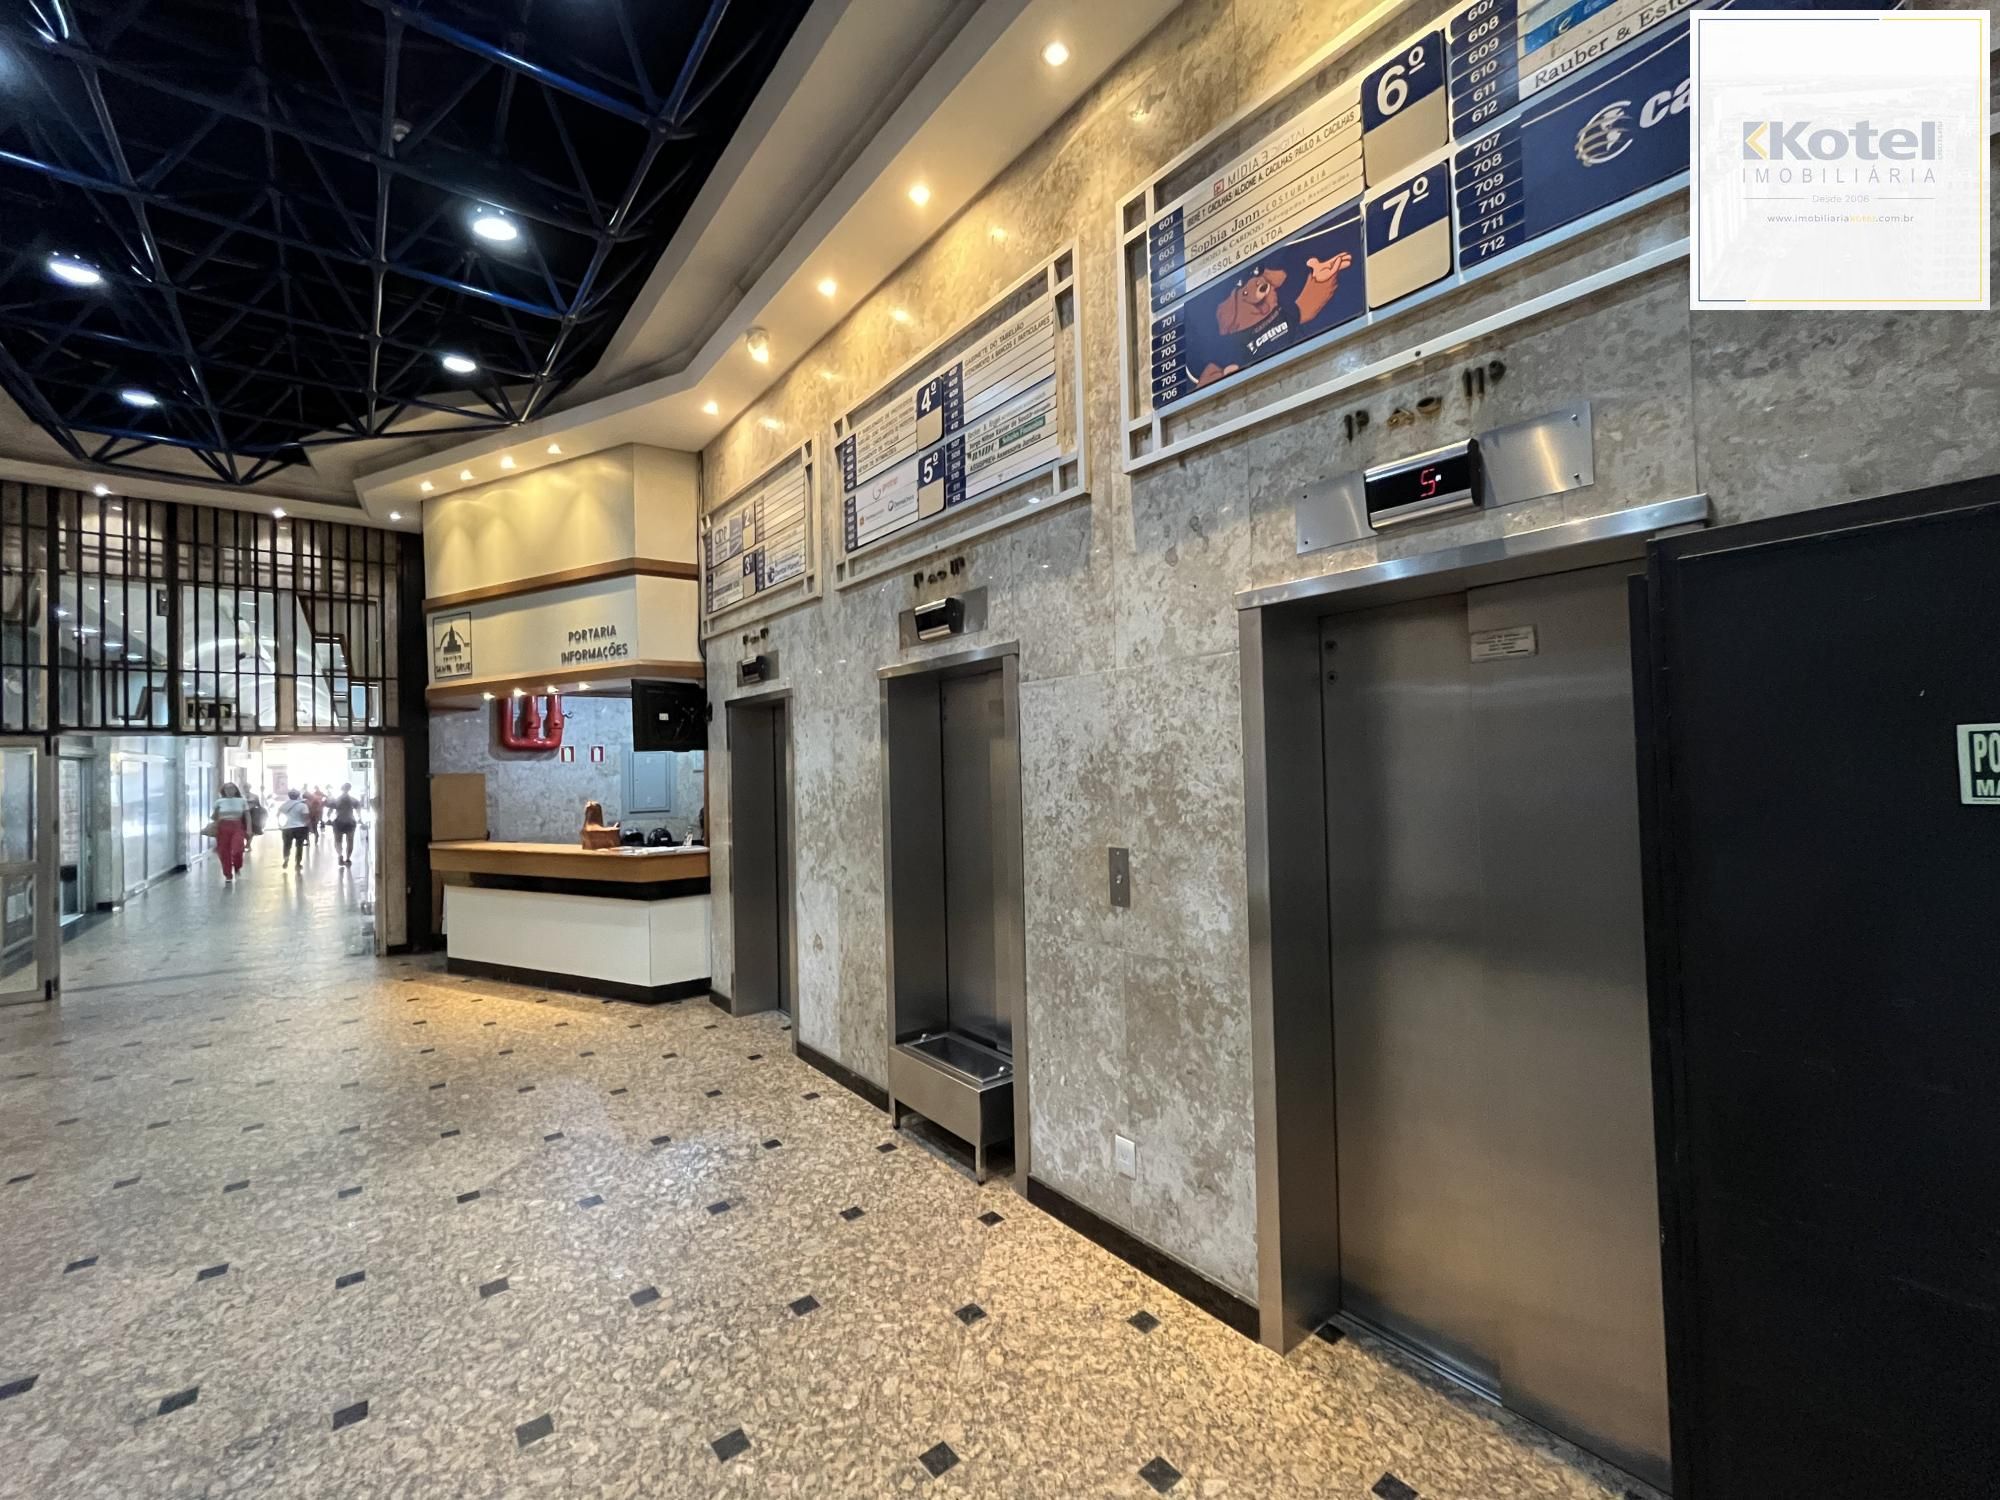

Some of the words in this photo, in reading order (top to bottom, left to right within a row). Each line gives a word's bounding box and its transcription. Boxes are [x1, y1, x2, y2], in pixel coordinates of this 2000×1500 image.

[1468, 15, 1499, 43] 608
[1468, 37, 1499, 64] 609
[1534, 37, 1608, 89] Rauber
[1616, 26, 1631, 41] &
[1377, 46, 1426, 116] 6º
[1470, 60, 1497, 83] 610
[1473, 81, 1496, 102] 611
[1471, 101, 1498, 123] 612
[1474, 133, 1500, 157] 707
[1473, 153, 1503, 176] 708
[1475, 173, 1504, 196] 709
[1383, 176, 1429, 241] 7º
[1479, 192, 1506, 214] 710
[1159, 215, 1174, 231] 601
[1190, 230, 1227, 259] Sophia
[1232, 208, 1259, 233] Jann
[1481, 215, 1504, 234] 711
[1158, 231, 1174, 246] 602
[1480, 235, 1505, 256] 712
[1158, 246, 1175, 261] 603
[1162, 315, 1176, 328] 701
[1161, 330, 1177, 344] 702
[1161, 344, 1177, 359] 703
[1161, 359, 1177, 373] 704
[1161, 373, 1177, 387] 705
[921, 381, 937, 413] 4º
[1161, 387, 1178, 401] 706
[923, 451, 939, 484] 5º
[568, 624, 617, 645] PORTARIA
[560, 642, 629, 665] INFORMAÇÕES
